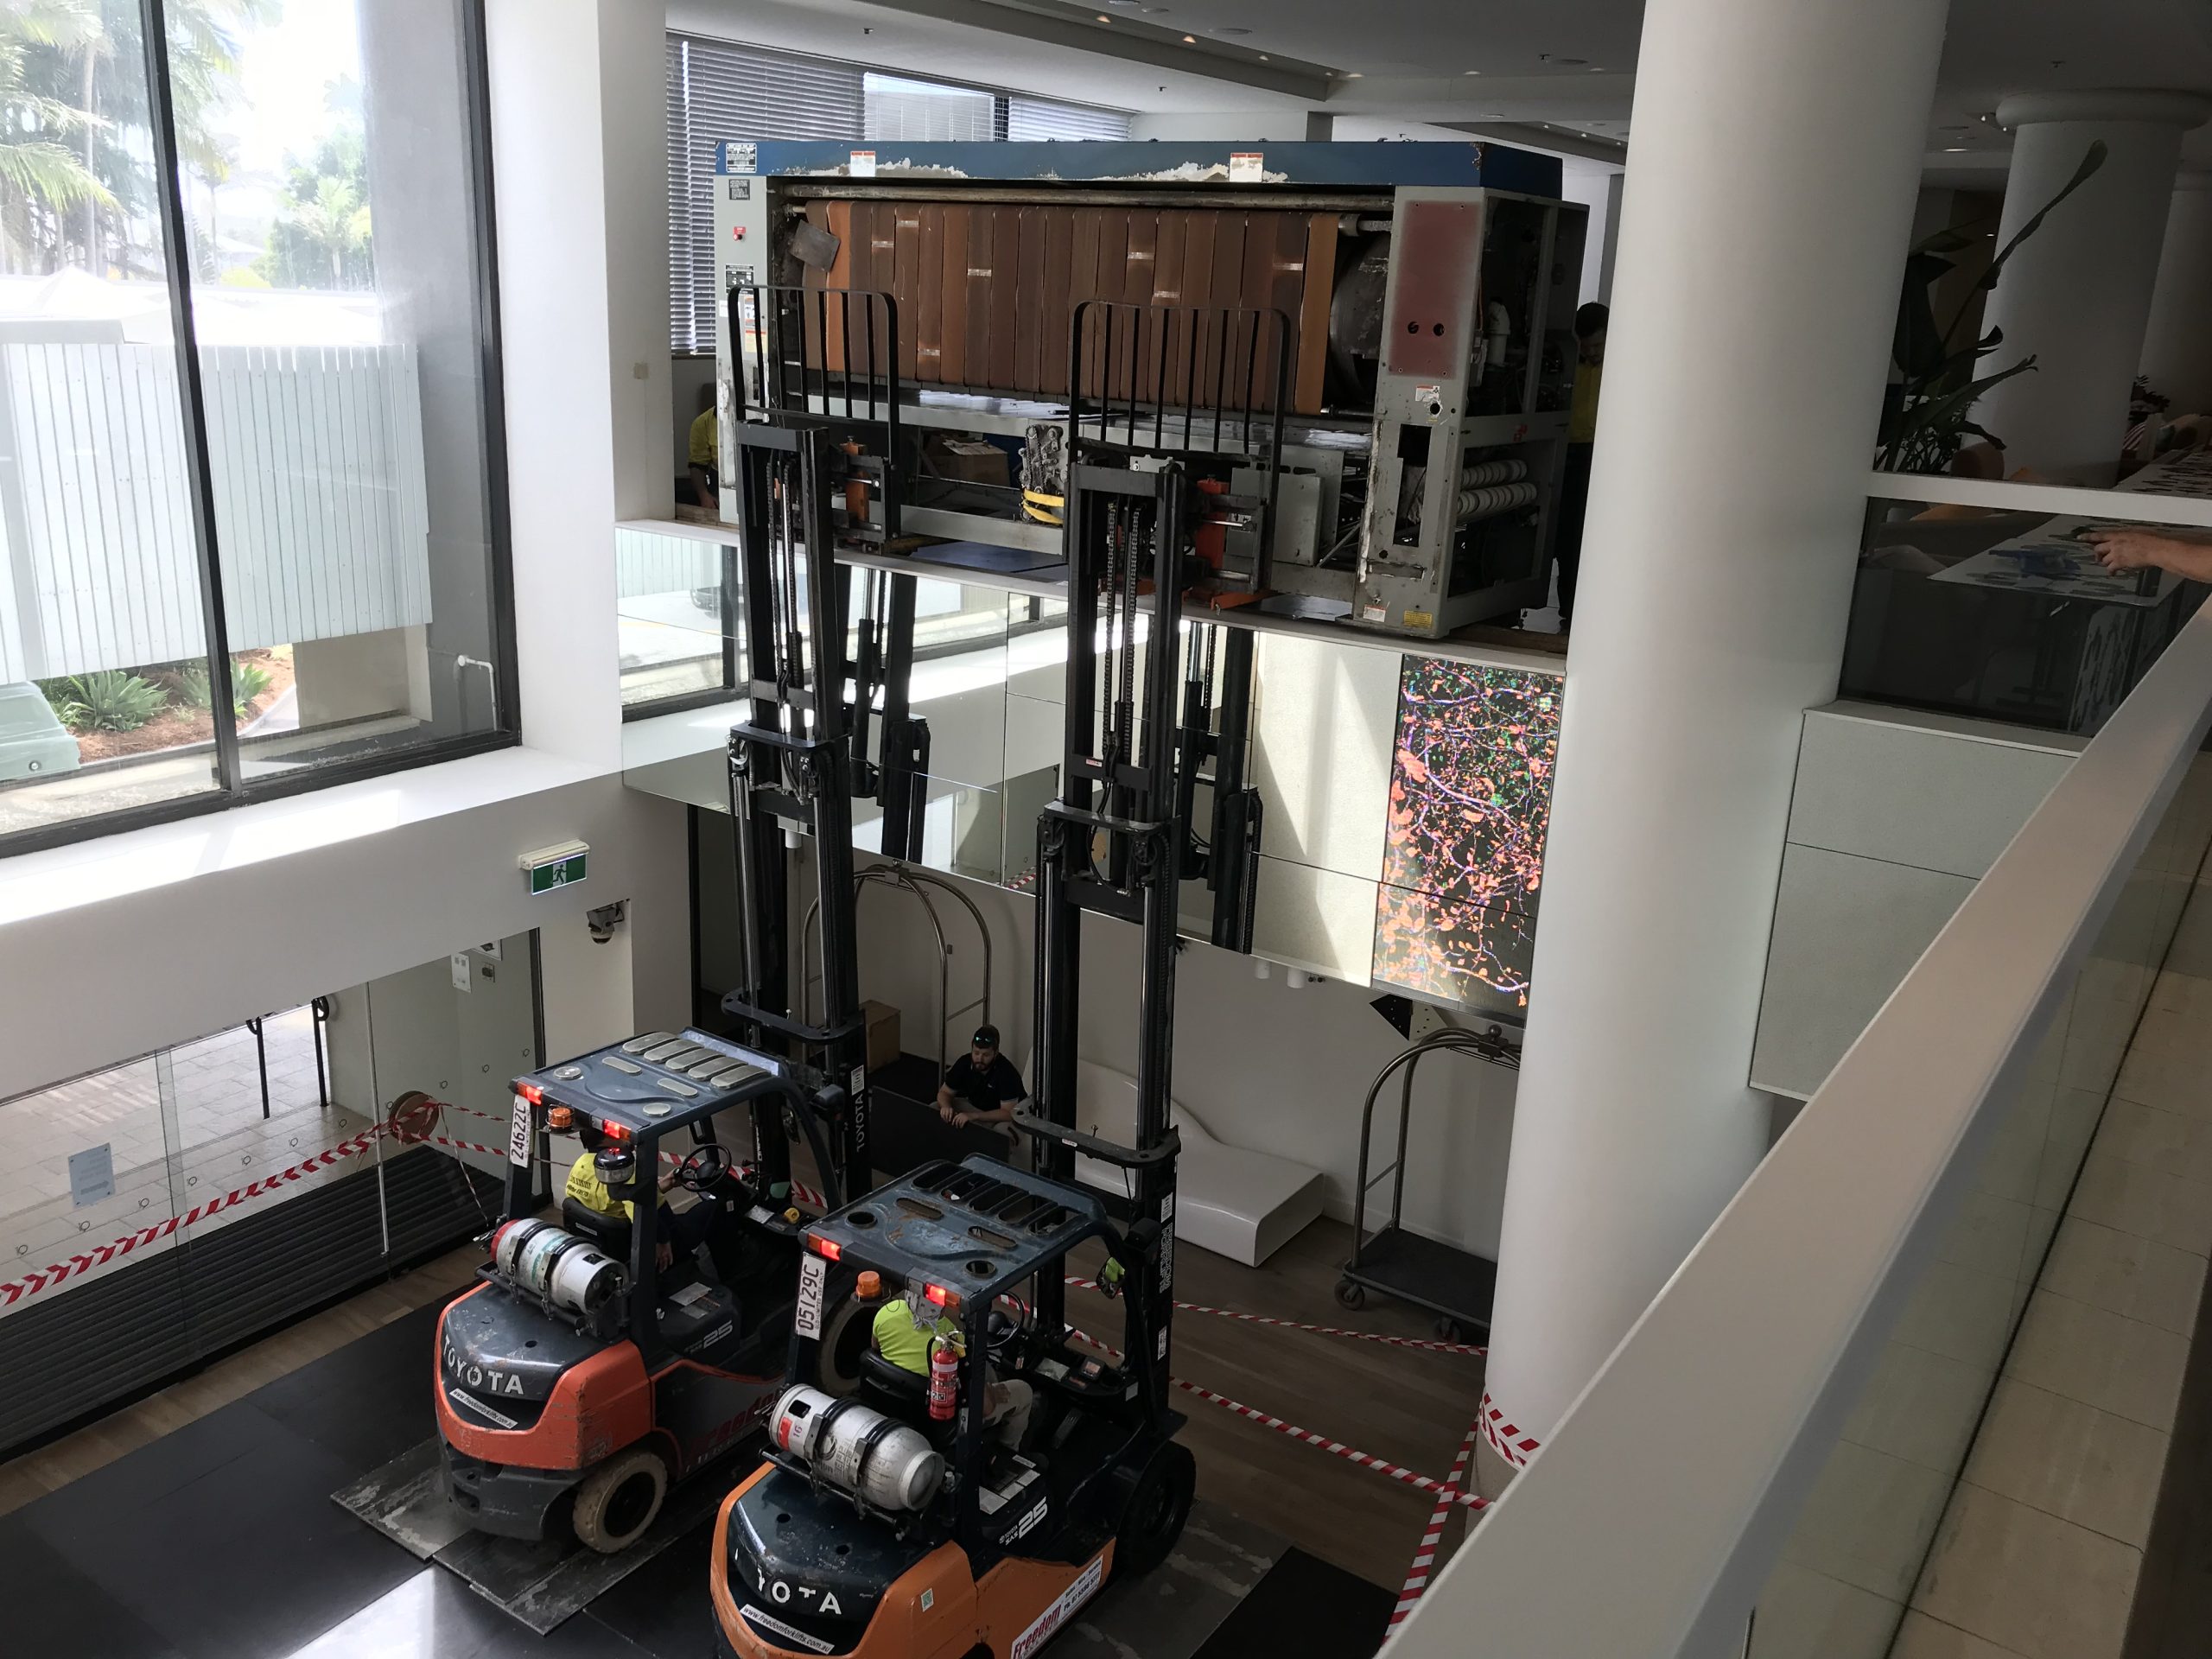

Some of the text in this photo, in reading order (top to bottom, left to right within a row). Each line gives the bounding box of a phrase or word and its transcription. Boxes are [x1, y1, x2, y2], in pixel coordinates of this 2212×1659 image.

[512, 1102, 527, 1160] 24622C
[855, 1094, 865, 1153] TOYOTA
[798, 1263, 819, 1331] 05129C
[703, 1319, 733, 1348] 25
[443, 1334, 524, 1395] TOYOTA
[1019, 1496, 1048, 1539] 25
